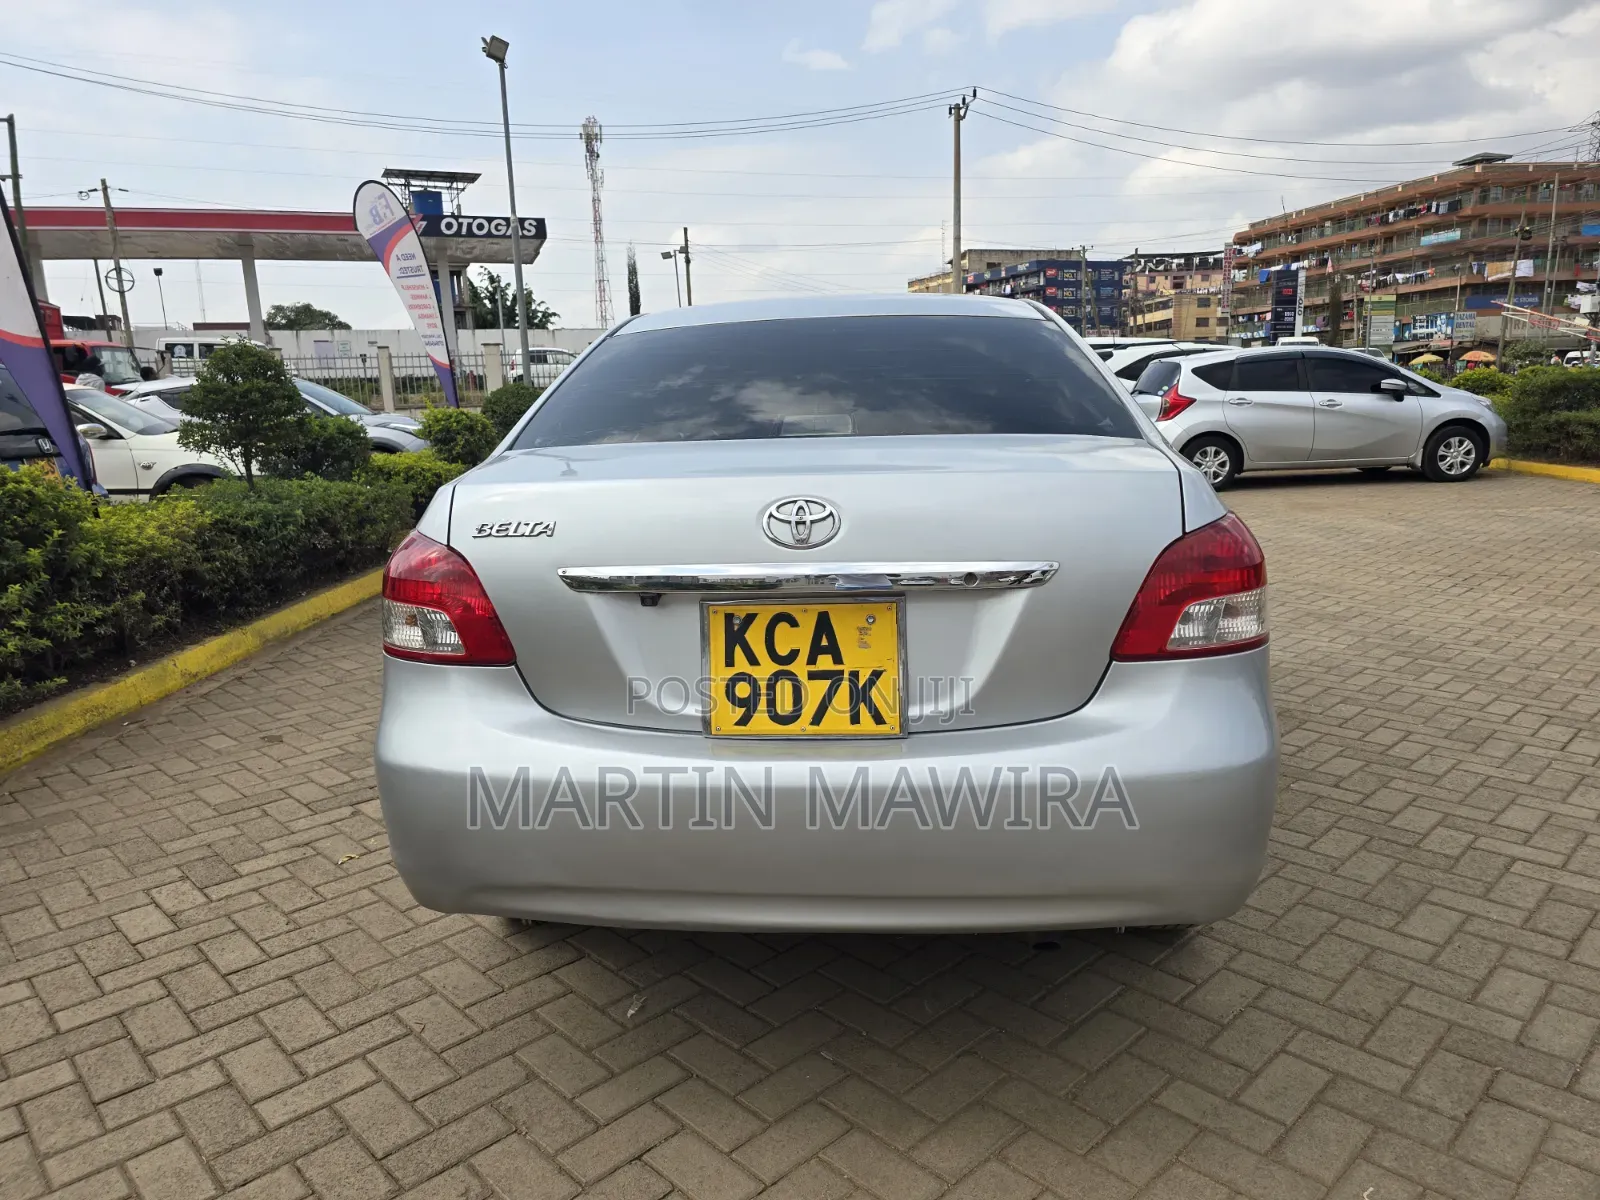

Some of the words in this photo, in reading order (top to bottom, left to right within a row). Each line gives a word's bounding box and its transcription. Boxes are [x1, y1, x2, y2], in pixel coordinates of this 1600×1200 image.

[1455, 321, 1475, 329] DENTAL
[472, 520, 557, 539] BELTA
[724, 611, 845, 667] KCA
[725, 669, 888, 727] 907K
